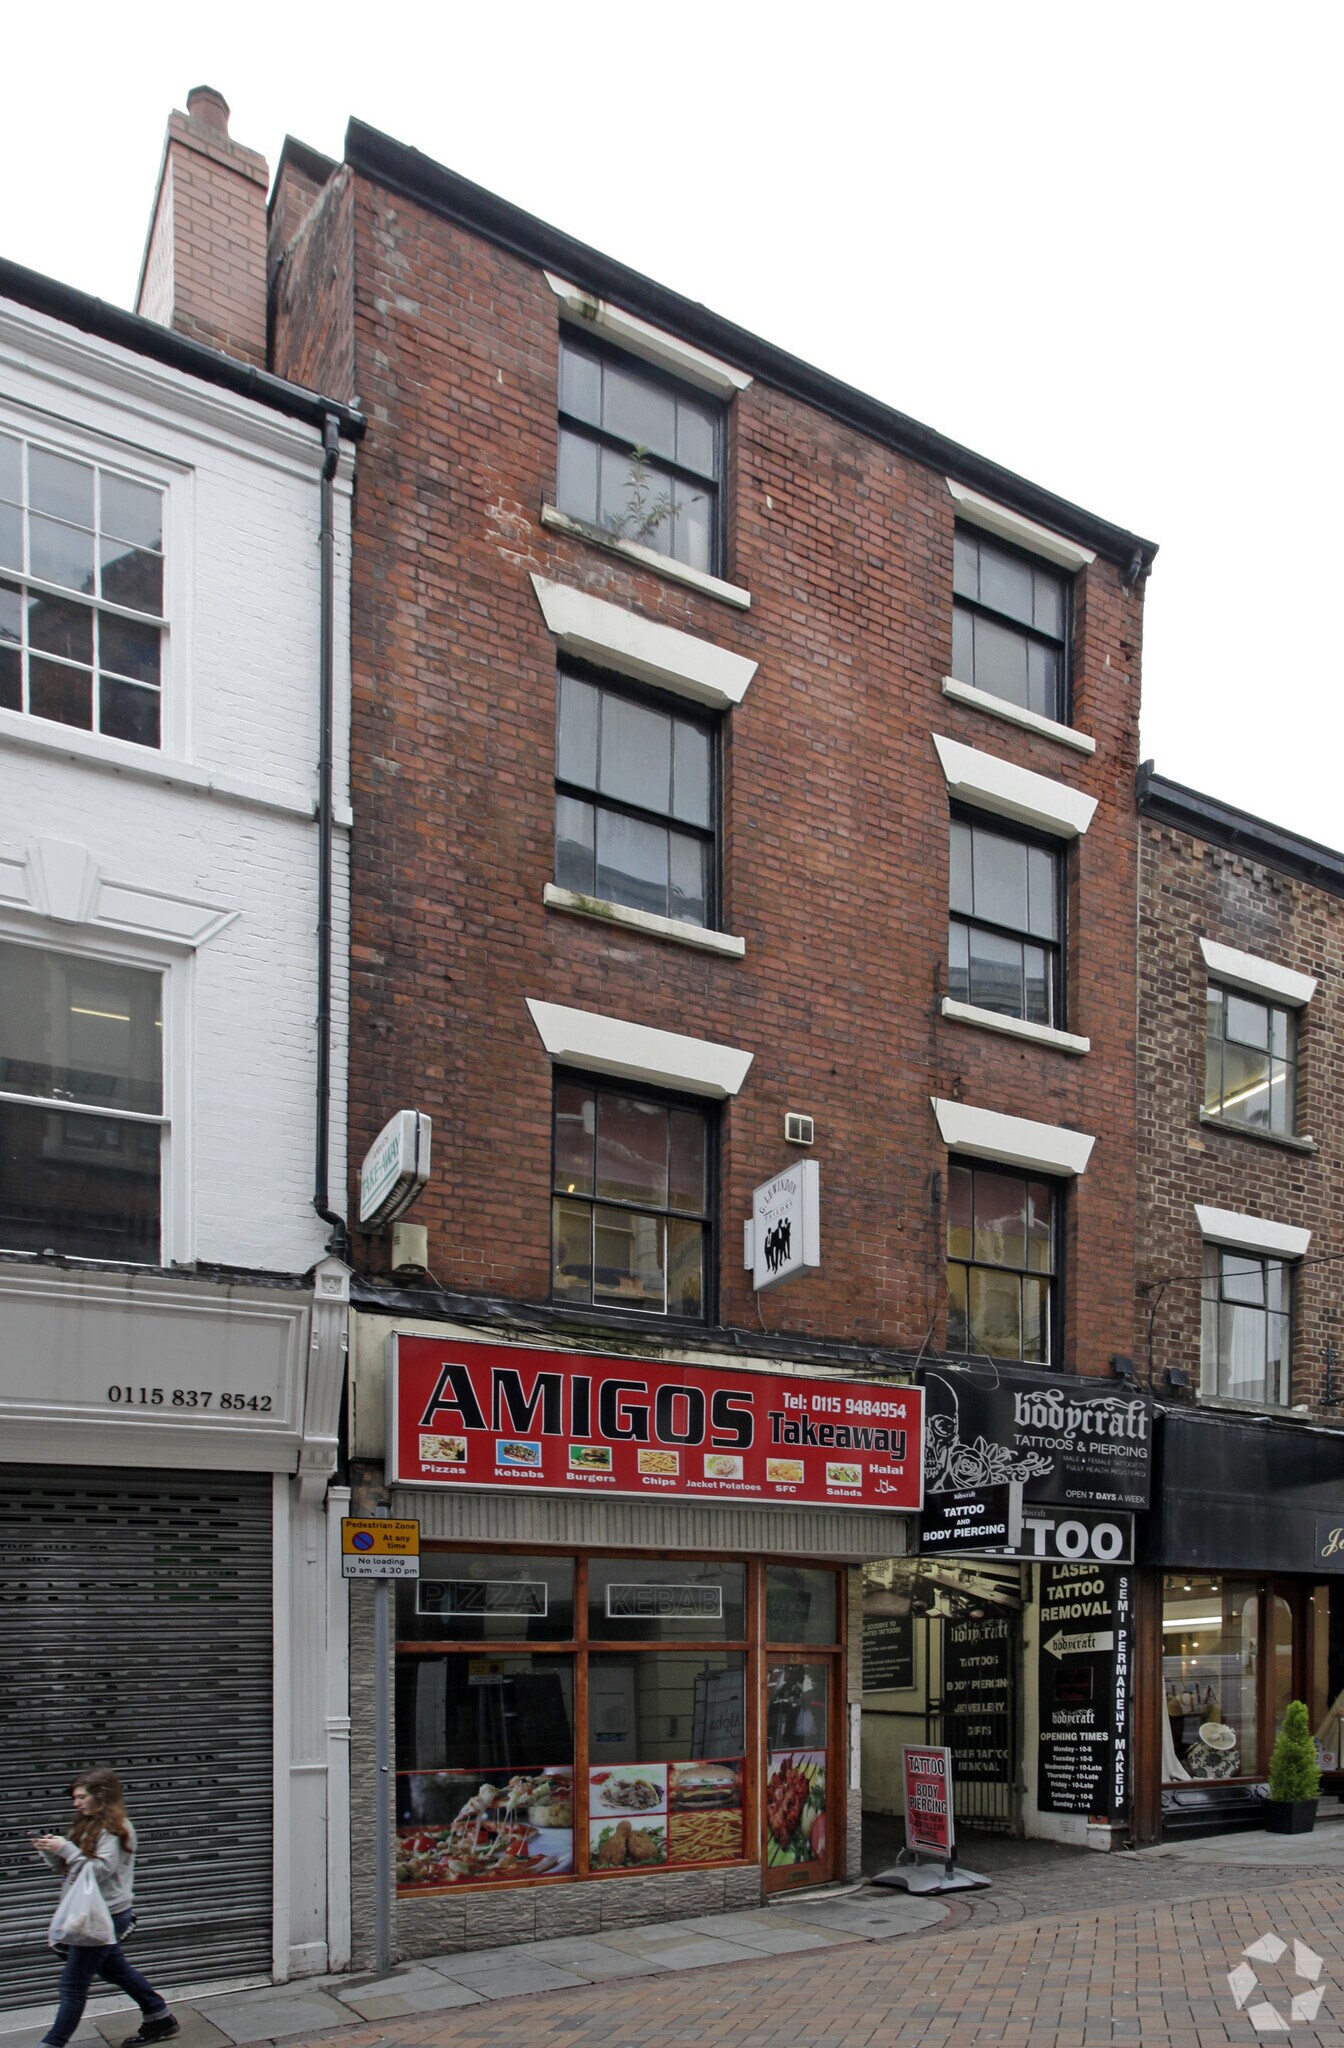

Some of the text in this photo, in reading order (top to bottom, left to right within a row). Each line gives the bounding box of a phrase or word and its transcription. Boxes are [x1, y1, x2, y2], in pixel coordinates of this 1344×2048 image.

[763, 1178, 798, 1204] LEWINDON
[764, 1201, 793, 1222] TAILORS
[108, 1385, 272, 1411] 0115 837 8542
[418, 1362, 755, 1450] AMIGOS
[782, 1392, 906, 1419] Tel: 0115 9484954
[1013, 1388, 1149, 1440] bodycraft
[767, 1410, 907, 1461] Takeaway
[1013, 1434, 1148, 1458] TATTOOS & PIERCING
[421, 1464, 466, 1474] Pizzas
[494, 1468, 545, 1479] Kebabs
[566, 1472, 616, 1483] Burgers
[869, 1464, 903, 1475] Halal
[642, 1476, 676, 1487] Chips
[686, 1479, 761, 1491] Jacket Potatoes
[775, 1484, 797, 1493] SFC
[826, 1488, 862, 1497] Salads
[1065, 1489, 1087, 1499] OPEN
[1088, 1491, 1094, 1499] 7
[1095, 1491, 1116, 1501] DAYS
[1124, 1494, 1145, 1503] WEEK
[943, 1504, 985, 1518] TATTOO
[346, 1521, 392, 1529] Pedestrian
[956, 1518, 970, 1526] AND
[923, 1524, 1006, 1541] BODY PIERCING
[374, 1558, 405, 1566] loading
[420, 1582, 545, 1615] PIZZA
[1047, 1579, 1105, 1600] TATTOO
[611, 1587, 720, 1615] KEBAB
[1040, 1600, 1112, 1622] REMOVAL
[1052, 1633, 1096, 1652] bodycraft
[1114, 1577, 1128, 1808] SEMI PERMANENT MAKEUP
[1052, 1708, 1095, 1727] bodycraft
[1040, 1732, 1109, 1741] OPENING TIMES
[908, 1755, 945, 1776] TATTOO
[916, 1783, 938, 1799] BODY
[909, 1795, 947, 1815] PIERCING
